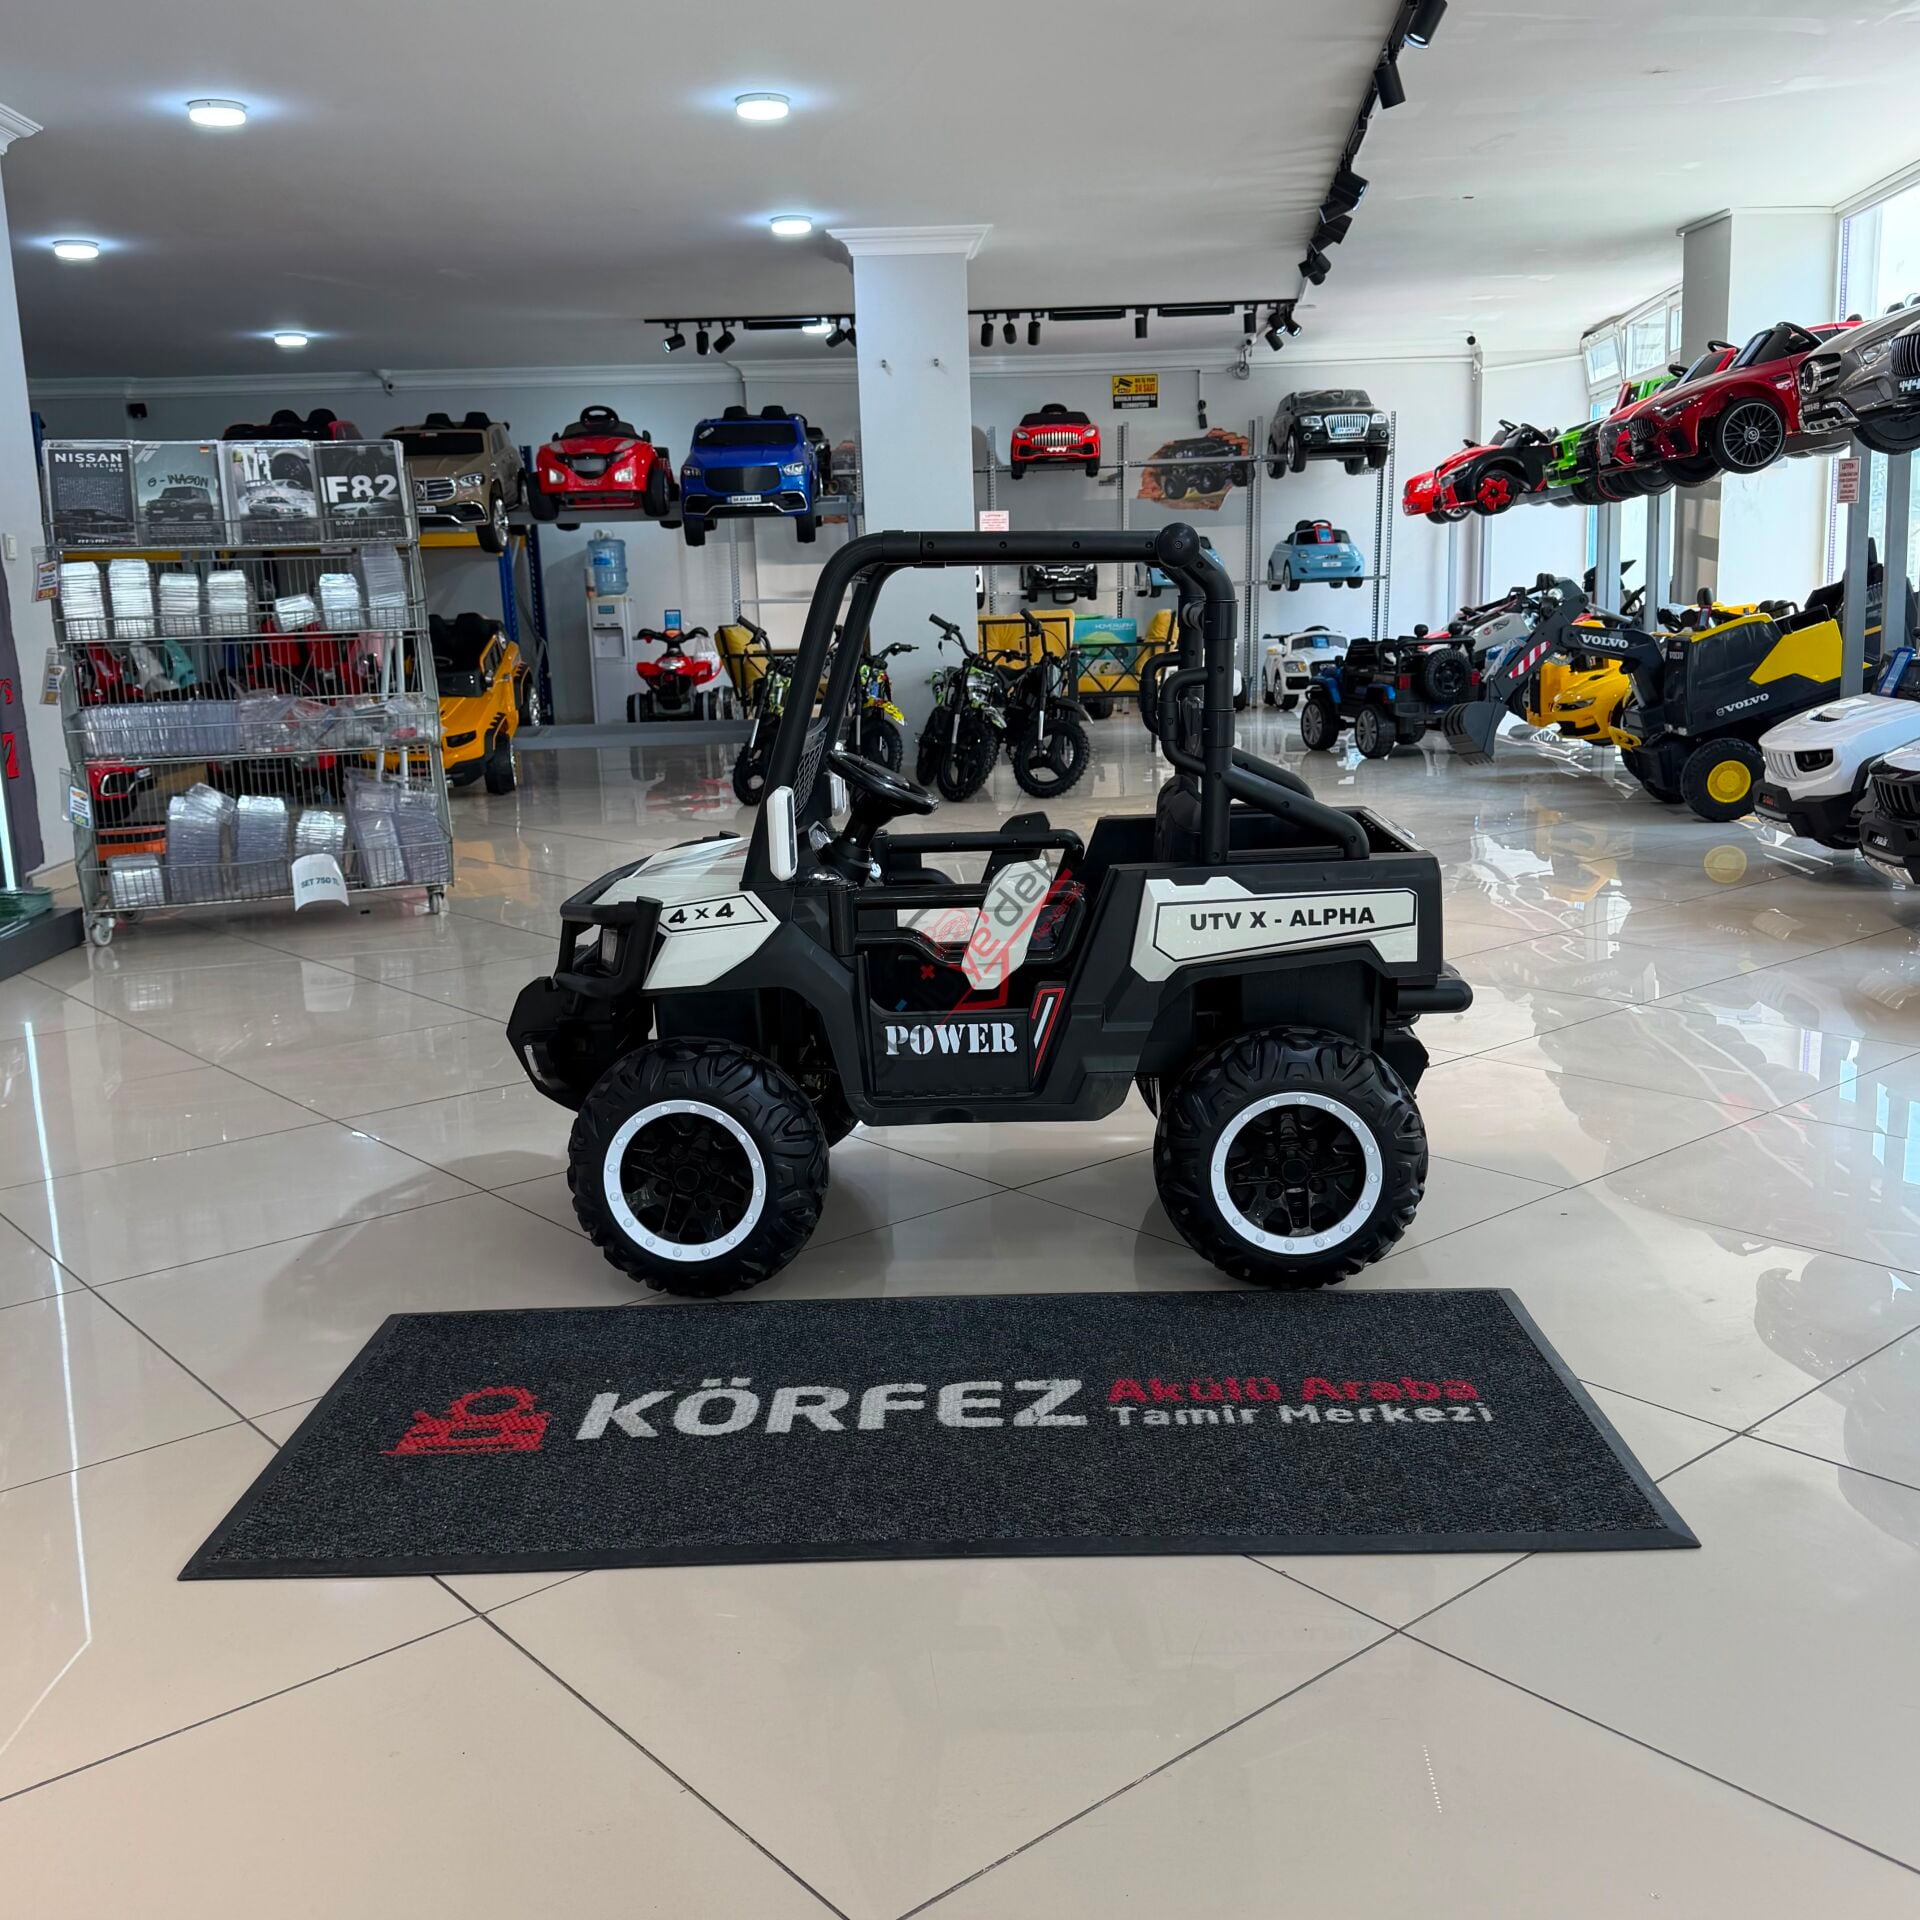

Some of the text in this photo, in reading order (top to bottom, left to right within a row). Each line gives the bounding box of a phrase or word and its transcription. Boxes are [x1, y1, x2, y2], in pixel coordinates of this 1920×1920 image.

[55, 453, 122, 463] NISSAN
[1580, 633, 1629, 649] VOLVO
[1724, 693, 1769, 713] VOLVO
[1190, 912, 1242, 930] UTV
[1249, 911, 1267, 928] X
[1289, 906, 1375, 927] ALPHA
[884, 1022, 1018, 1055] POWER
[1107, 1376, 1479, 1403] Akülü Araba
[576, 1377, 1088, 1441] KÖRFEZ
[1107, 1402, 1494, 1425] Tamir Merkezi
